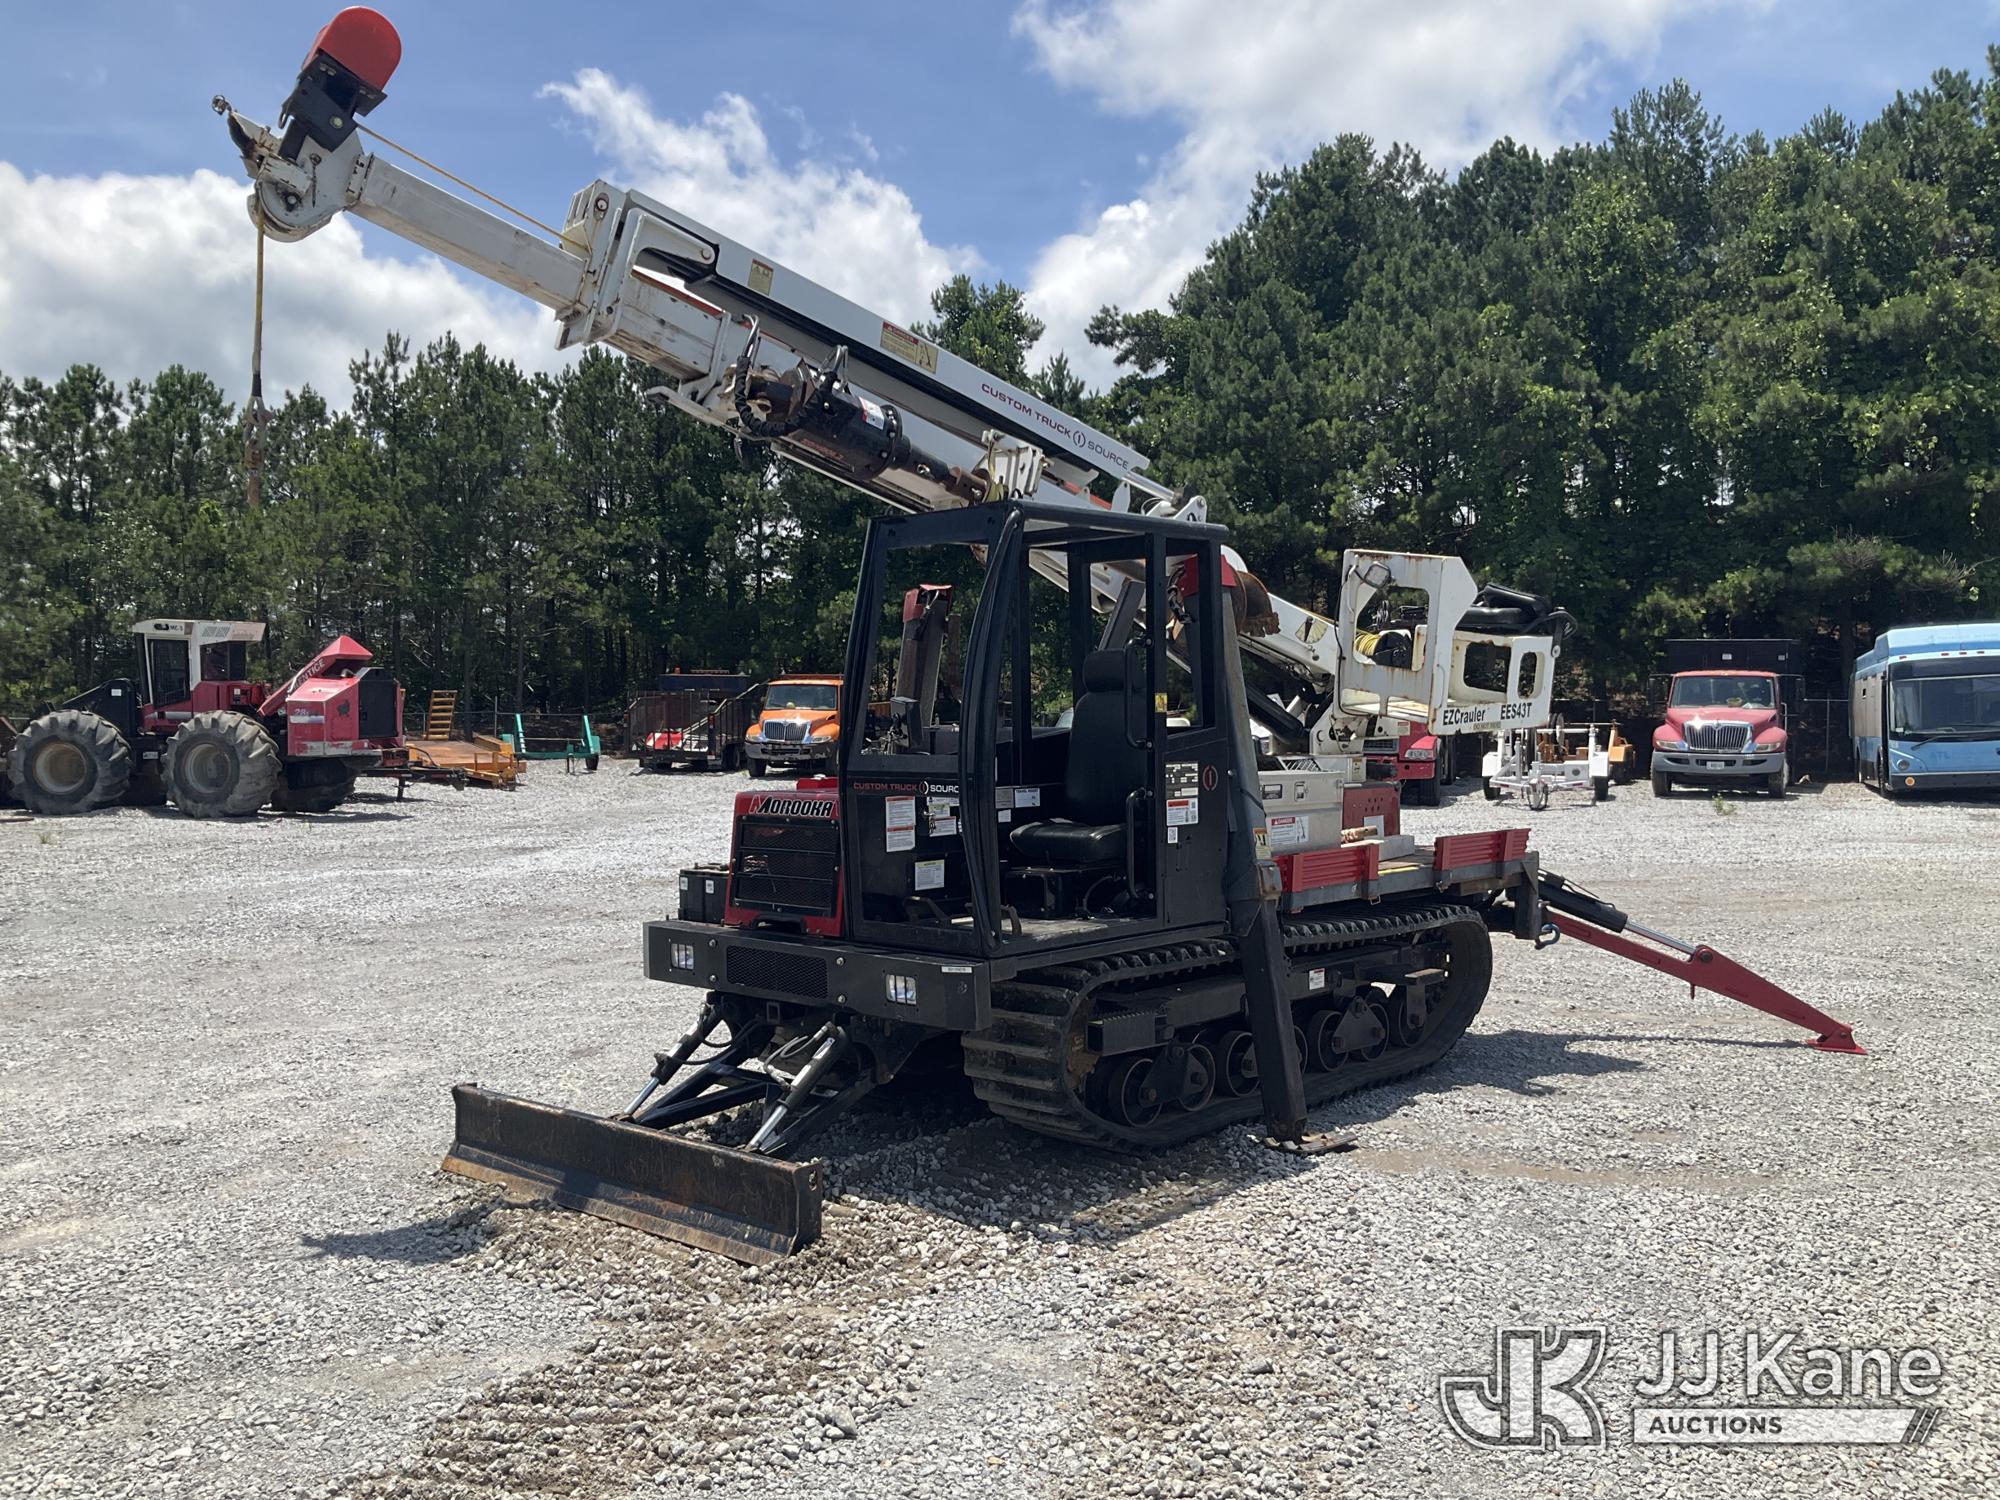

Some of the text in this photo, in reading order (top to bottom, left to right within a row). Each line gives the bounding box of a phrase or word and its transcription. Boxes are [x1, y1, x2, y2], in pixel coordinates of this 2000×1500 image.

[981, 383, 1129, 470] CUSTOM TRUCK SOURCE
[1500, 702, 1532, 720] EES43T
[853, 783, 960, 793] CUSTOM TRUCK SOURC
[749, 794, 834, 818] MOROOKA
